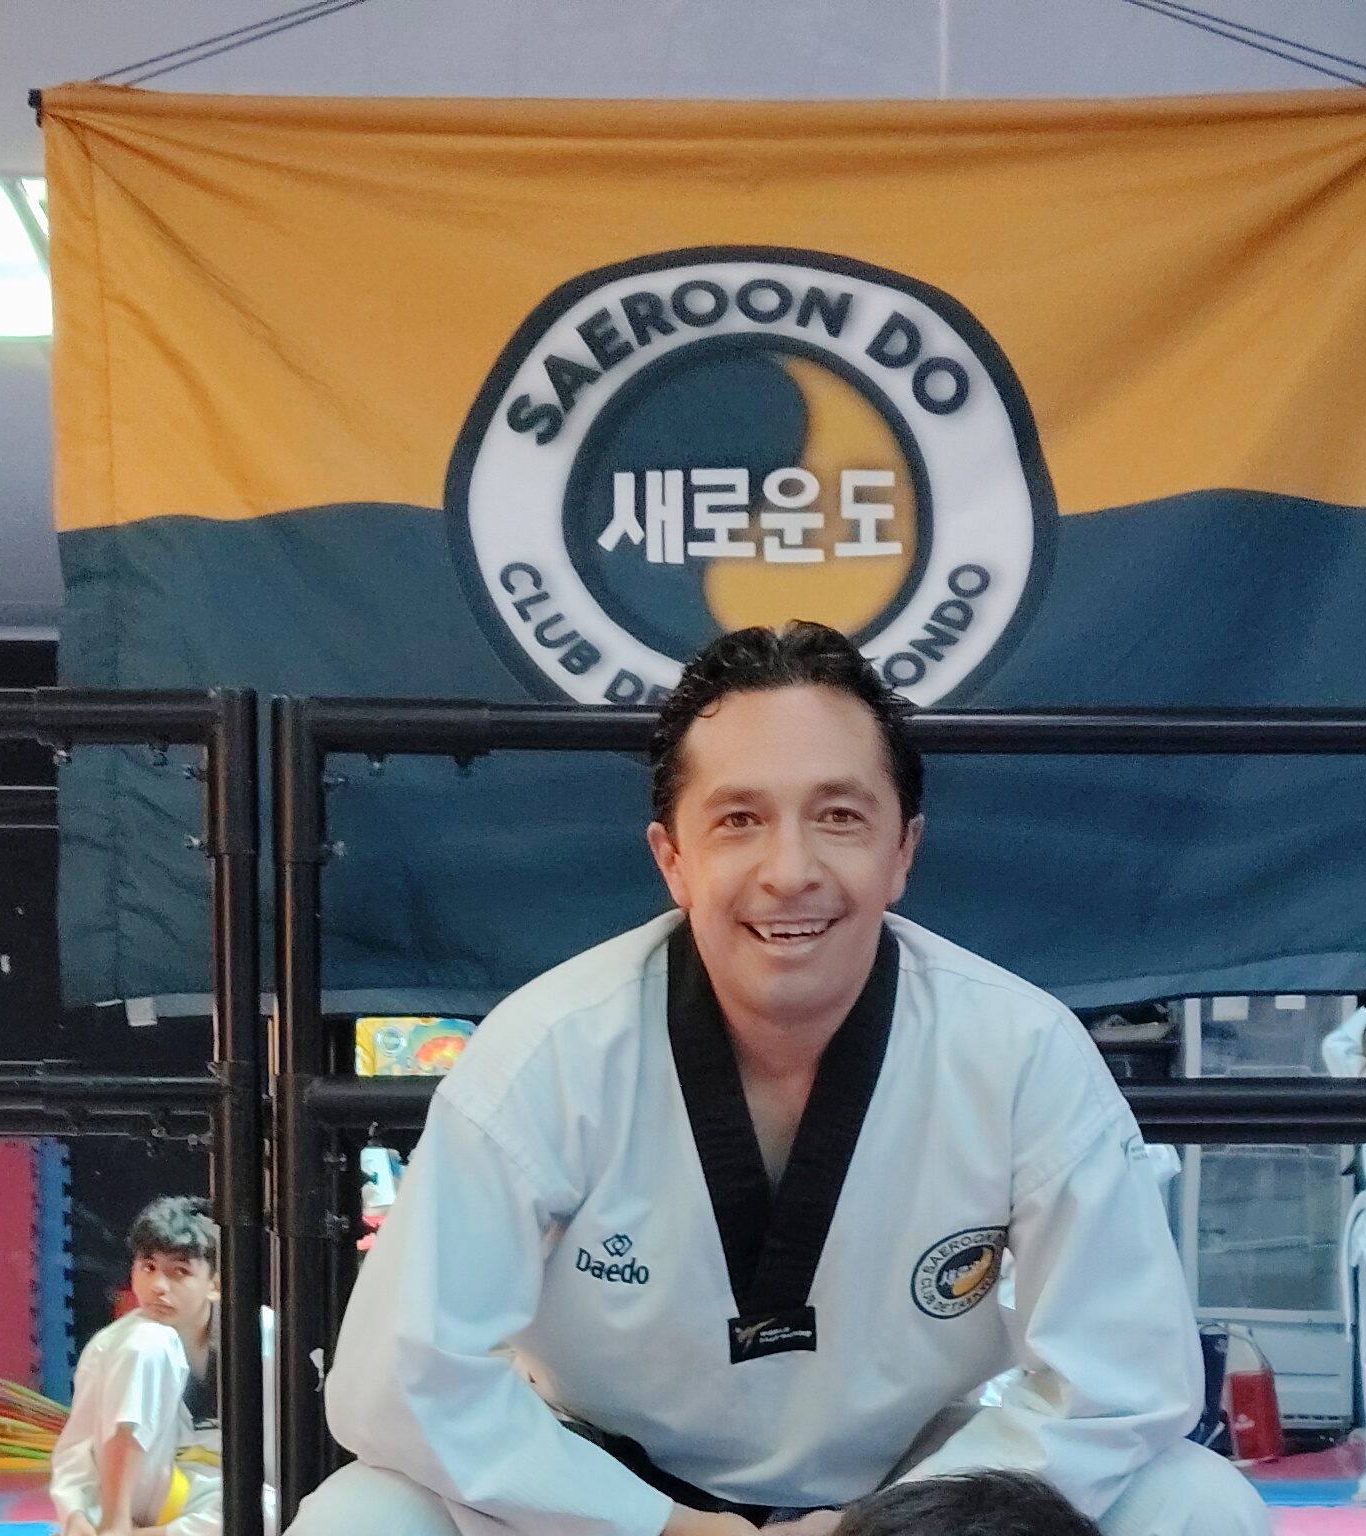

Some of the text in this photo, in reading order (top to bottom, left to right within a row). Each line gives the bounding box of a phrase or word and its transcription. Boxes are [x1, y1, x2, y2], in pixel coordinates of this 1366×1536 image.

[507, 278, 970, 445] SAEROON DO
[597, 466, 903, 564] 새로운도
[500, 561, 602, 676] CLUB
[883, 563, 991, 687] ONDO
[576, 1247, 649, 1284] Daedo
